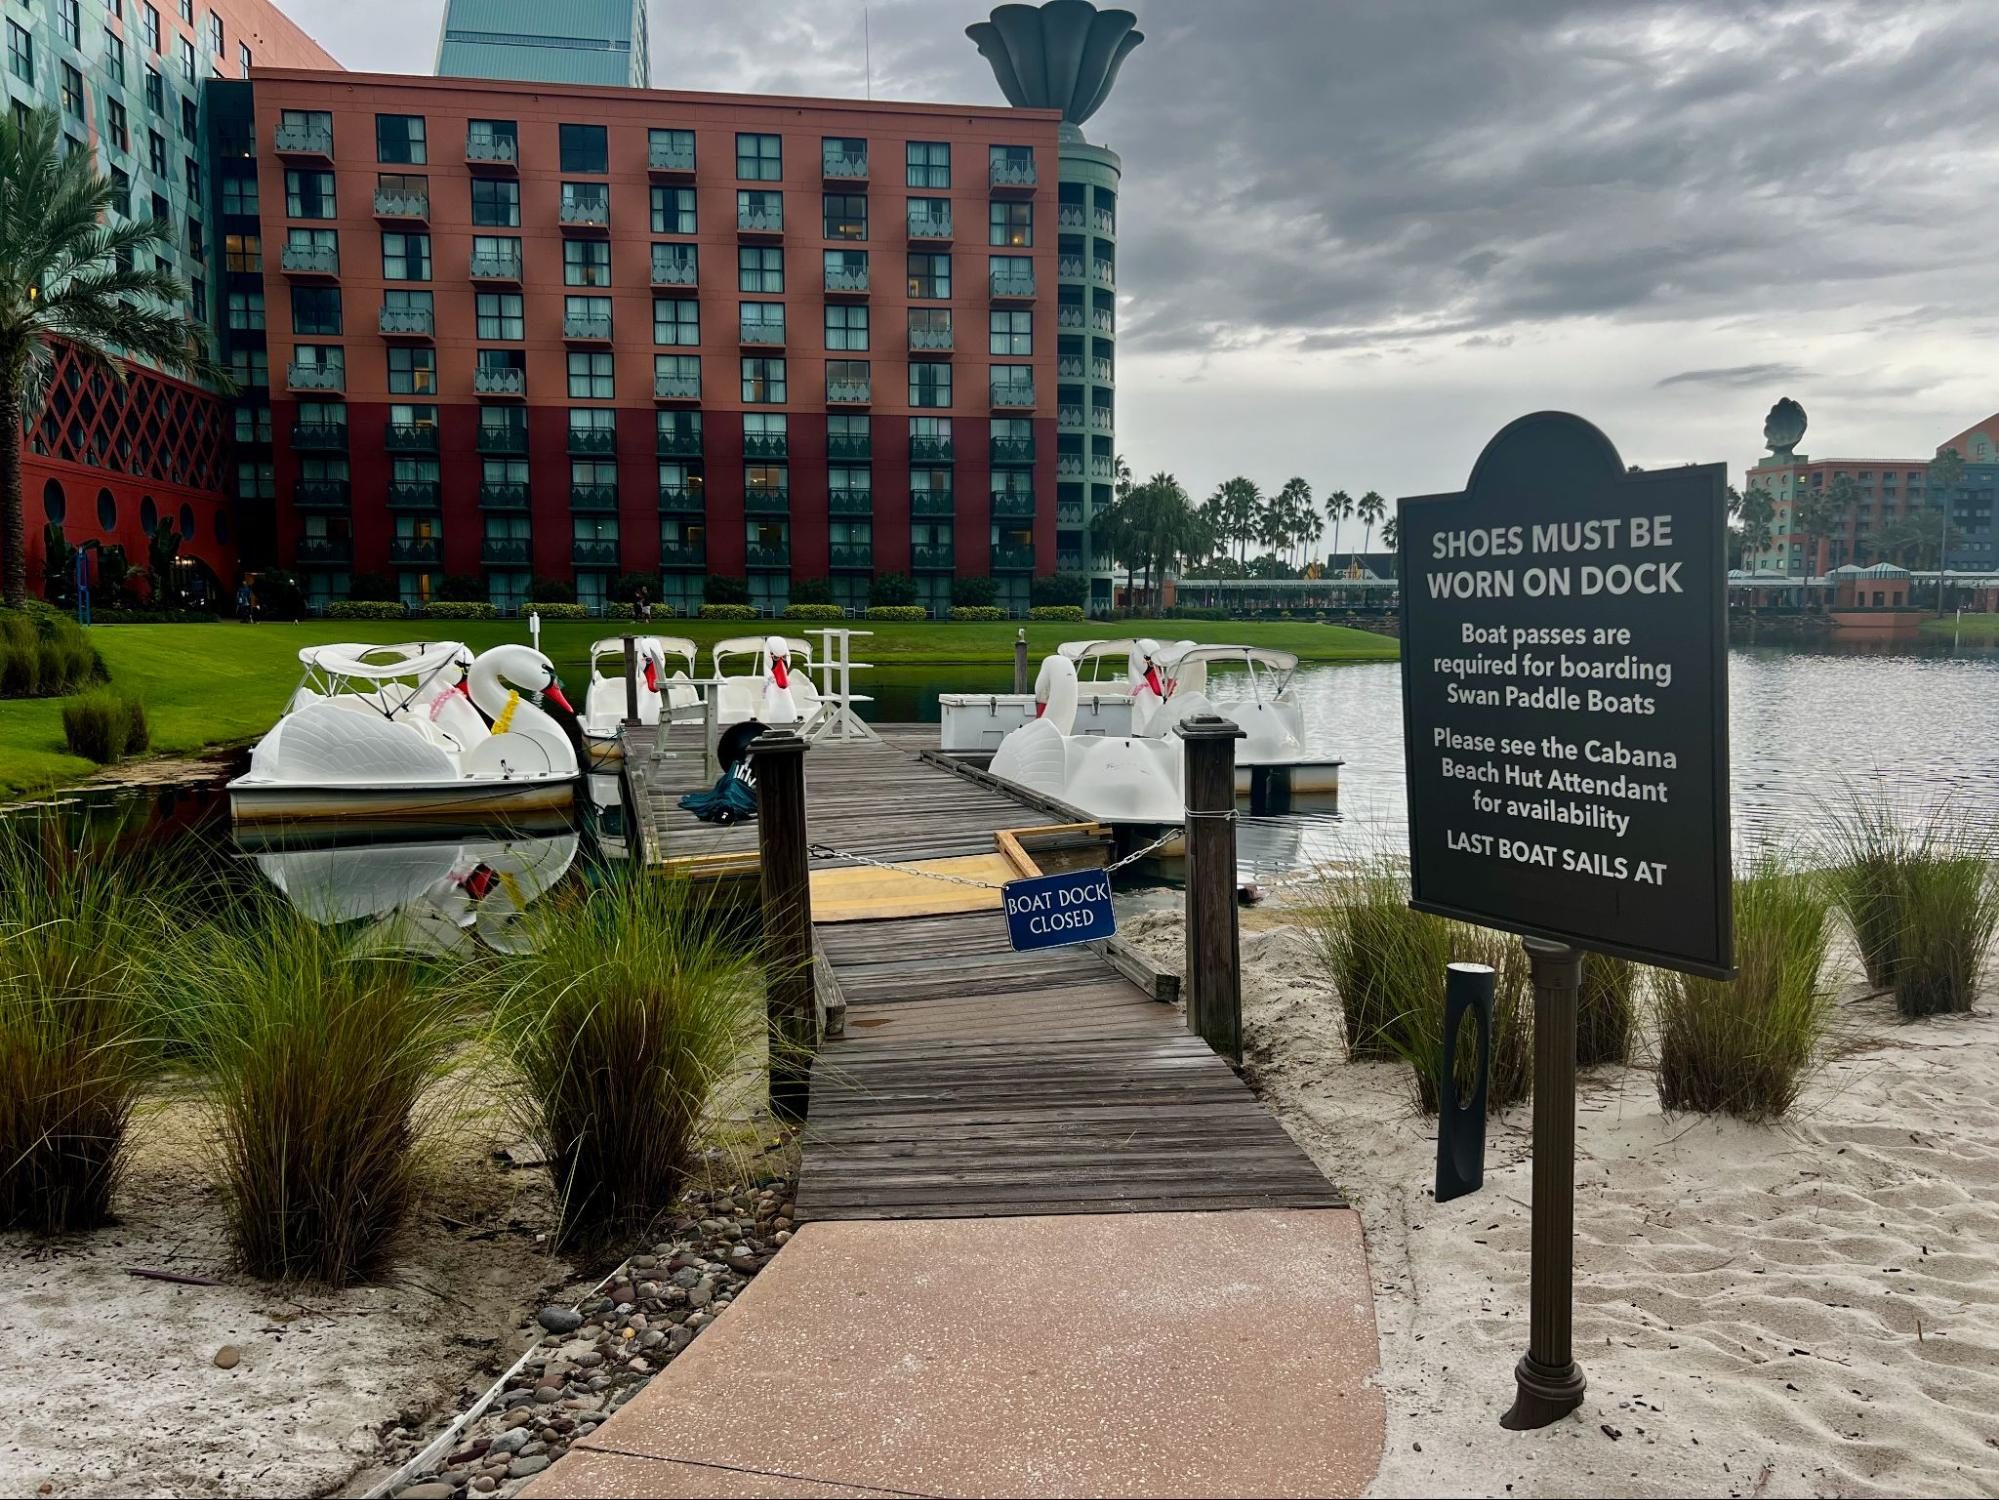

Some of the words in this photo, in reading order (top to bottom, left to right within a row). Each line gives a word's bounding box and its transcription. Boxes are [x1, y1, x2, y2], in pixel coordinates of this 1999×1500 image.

[1432, 526, 1523, 559] SHOES
[1532, 518, 1621, 553] MUST
[1630, 514, 1673, 548] BE
[1426, 569, 1514, 599] WORN
[1522, 566, 1571, 597] ON
[1580, 561, 1684, 596] DOCK
[1462, 622, 1508, 644] Boat
[1512, 628, 1587, 651] passes
[1592, 628, 1631, 646] are
[1434, 653, 1517, 680] required
[1522, 653, 1555, 677] for
[1560, 654, 1672, 688] boarding
[1447, 682, 1500, 706] Swan
[1505, 685, 1581, 711] Paddle
[1587, 689, 1655, 715] Boats
[1433, 727, 1496, 753] Please
[1500, 738, 1536, 757] see
[1540, 735, 1578, 761] the
[1584, 739, 1677, 769] Cabana
[1442, 757, 1499, 783] Beach
[1505, 764, 1543, 789] Hut
[1547, 769, 1669, 804] Attendant
[1472, 789, 1502, 813] for
[1506, 799, 1631, 838] availability
[1447, 829, 1494, 856] LAST
[1498, 838, 1558, 867] BOAT
[1562, 848, 1628, 880] SAILS
[1633, 860, 1668, 886] AT
[1007, 891, 1052, 915] BOAT
[1058, 882, 1108, 907] DOCK
[1030, 909, 1094, 934] CLOSED
